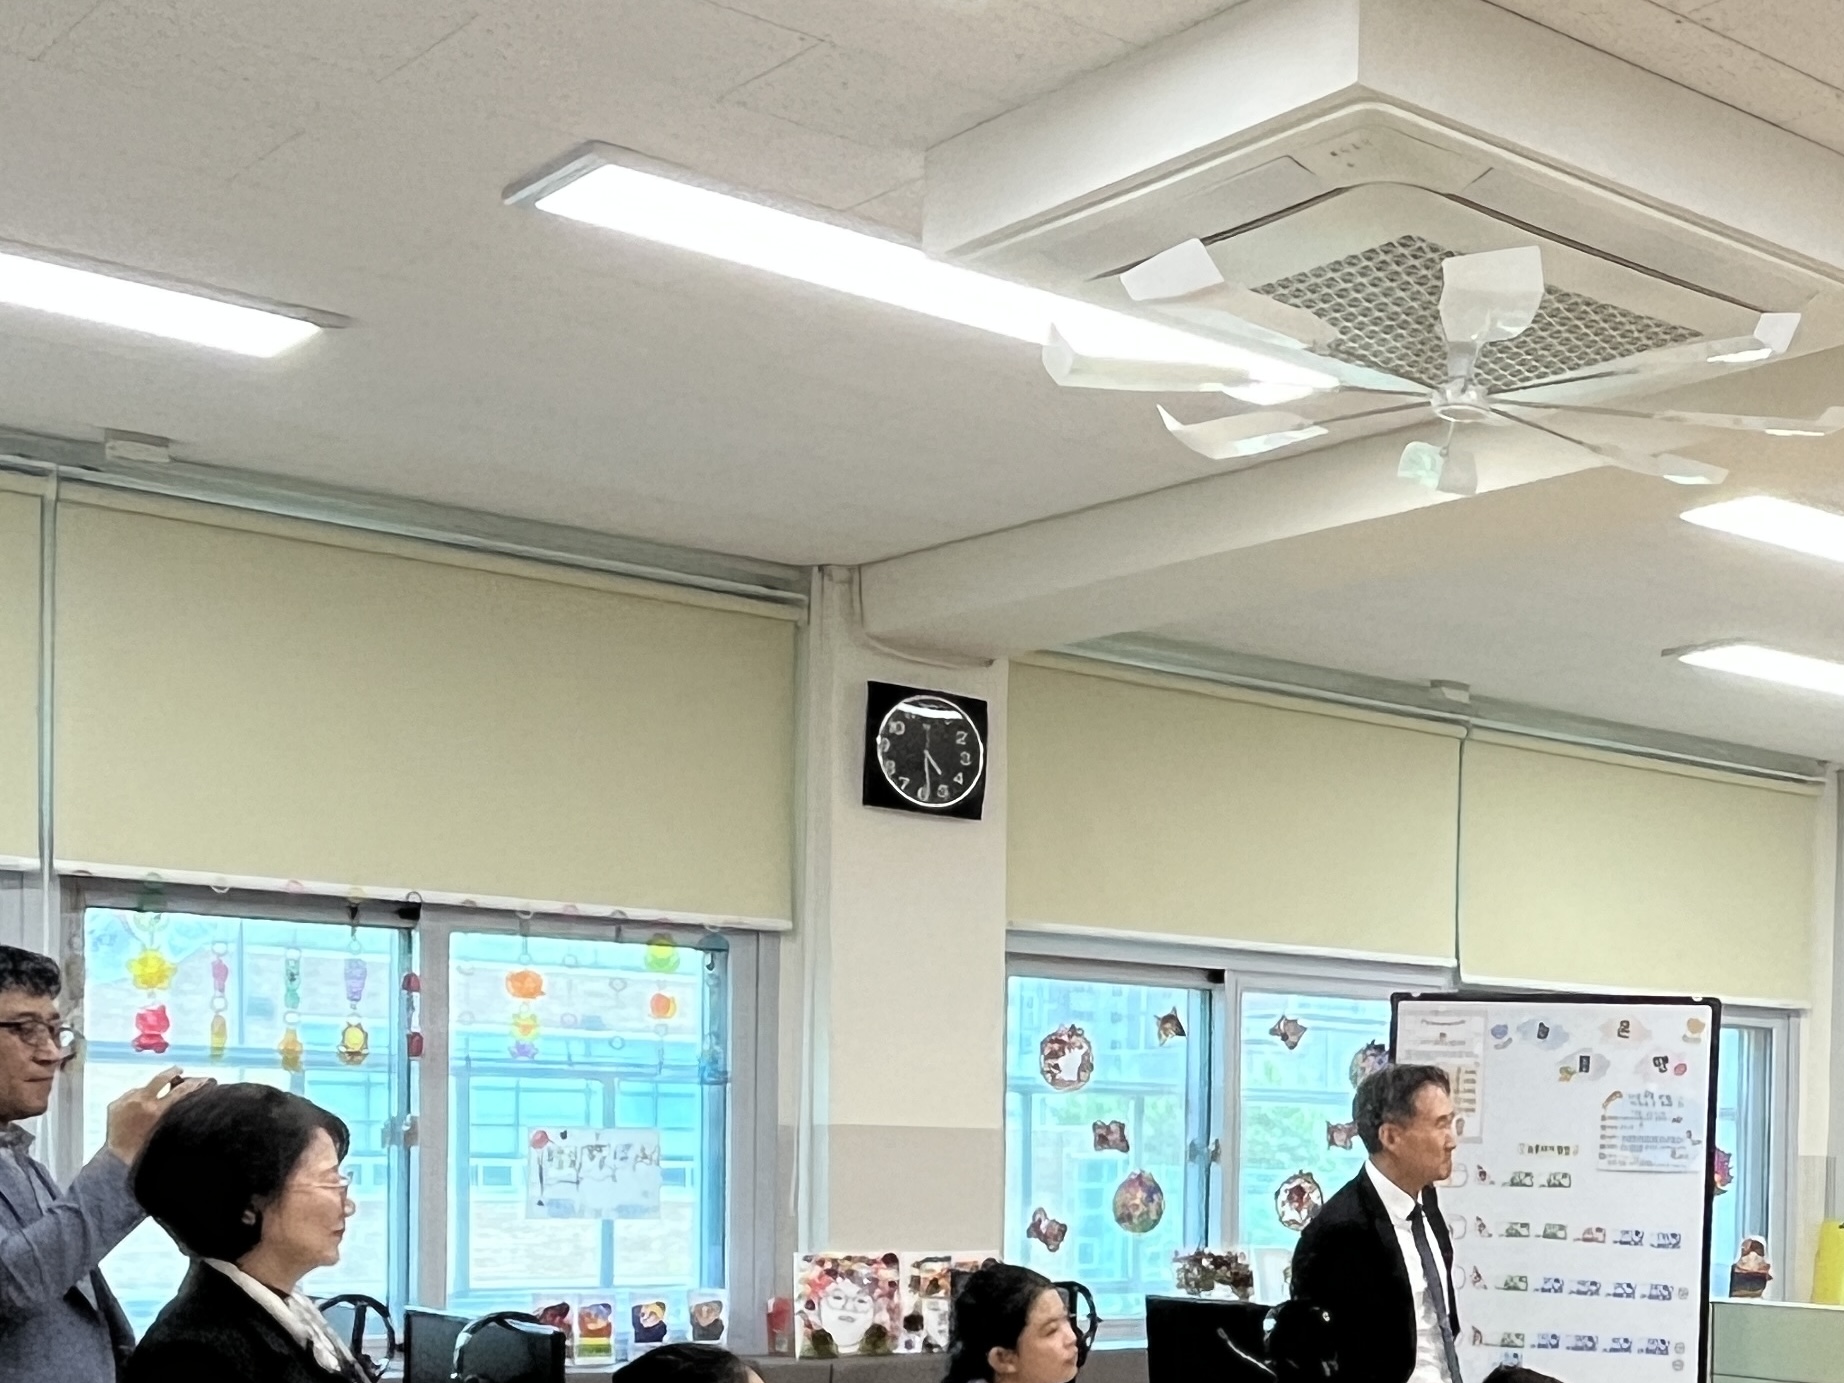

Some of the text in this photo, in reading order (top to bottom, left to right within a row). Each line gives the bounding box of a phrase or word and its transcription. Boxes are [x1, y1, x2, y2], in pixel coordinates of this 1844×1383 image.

[955, 730, 969, 745] 2
[898, 776, 910, 790] 7
[953, 771, 964, 785] 4
